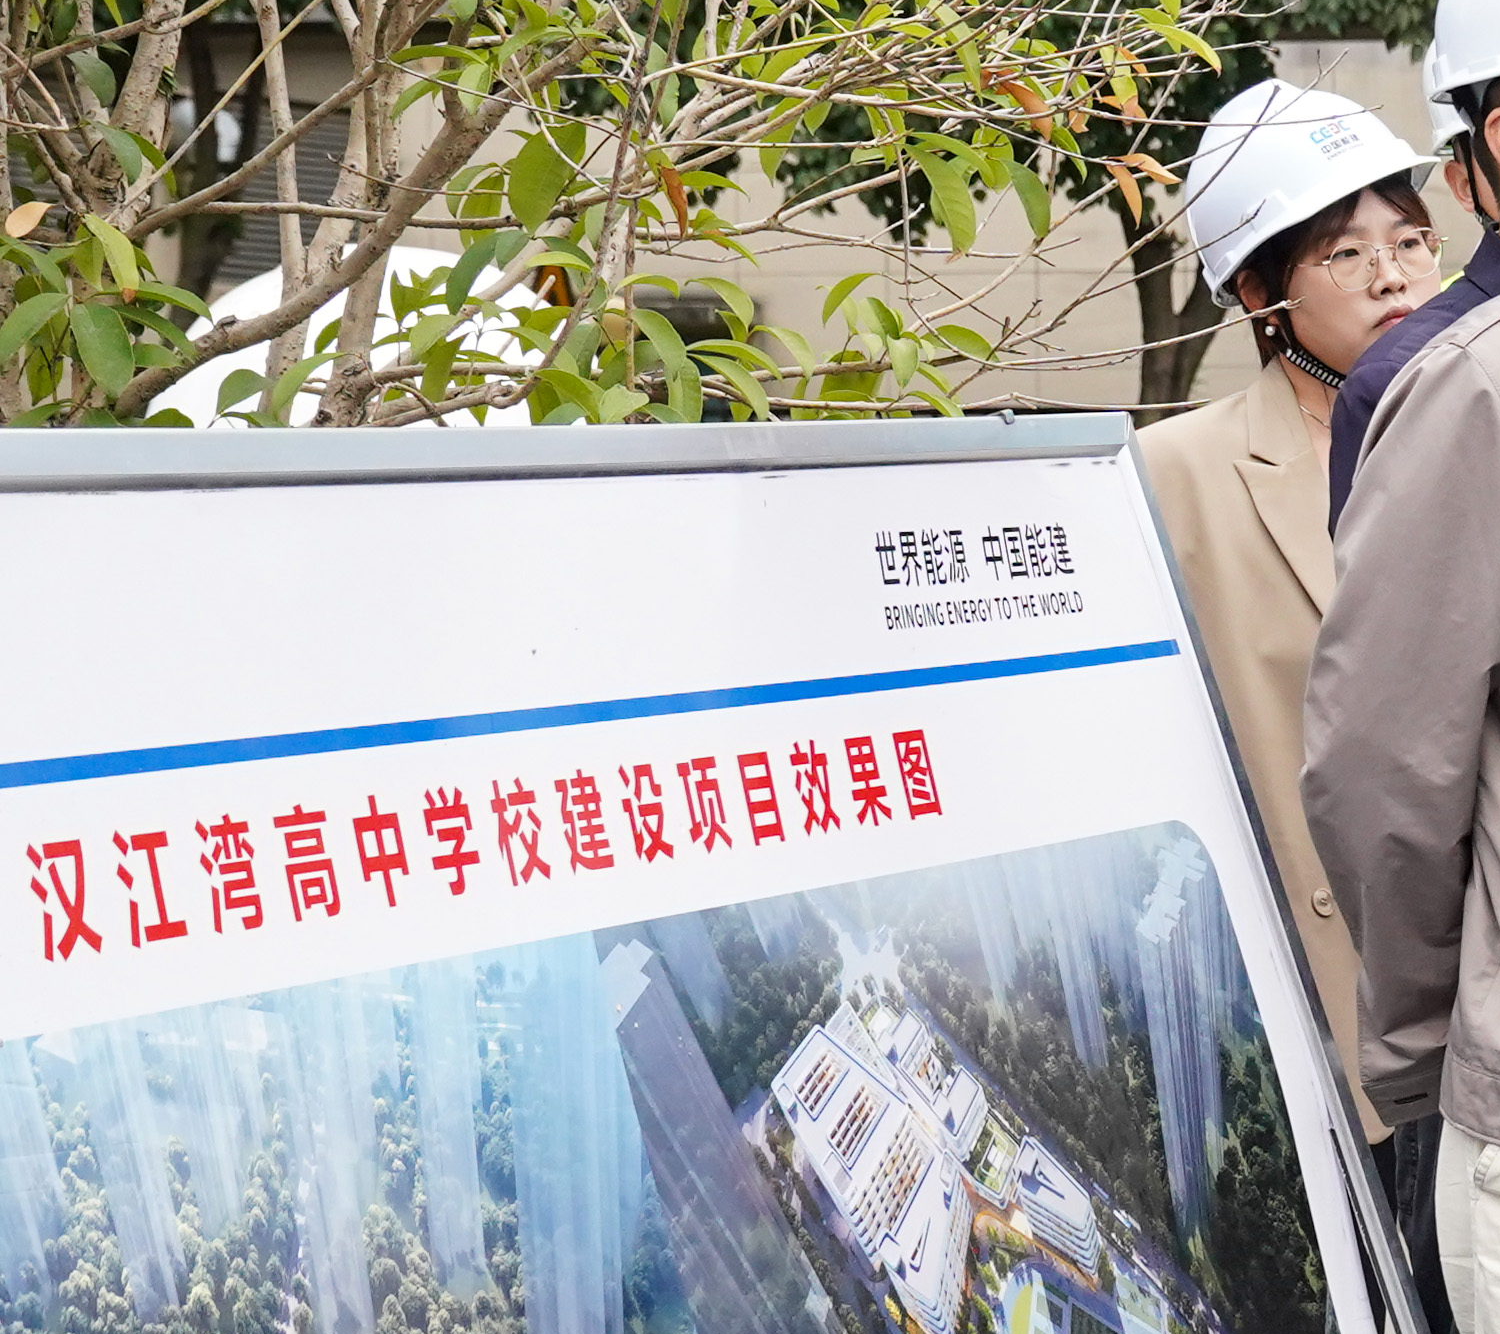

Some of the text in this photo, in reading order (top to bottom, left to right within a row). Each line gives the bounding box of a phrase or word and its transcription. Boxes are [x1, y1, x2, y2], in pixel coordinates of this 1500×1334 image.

[875, 522, 1075, 587] 世界能源 中国能建
[884, 590, 1084, 630] BRINGING ENERGY TO THE WORLD
[27, 728, 943, 963] 汉江湾高中学校建设项目效果图
